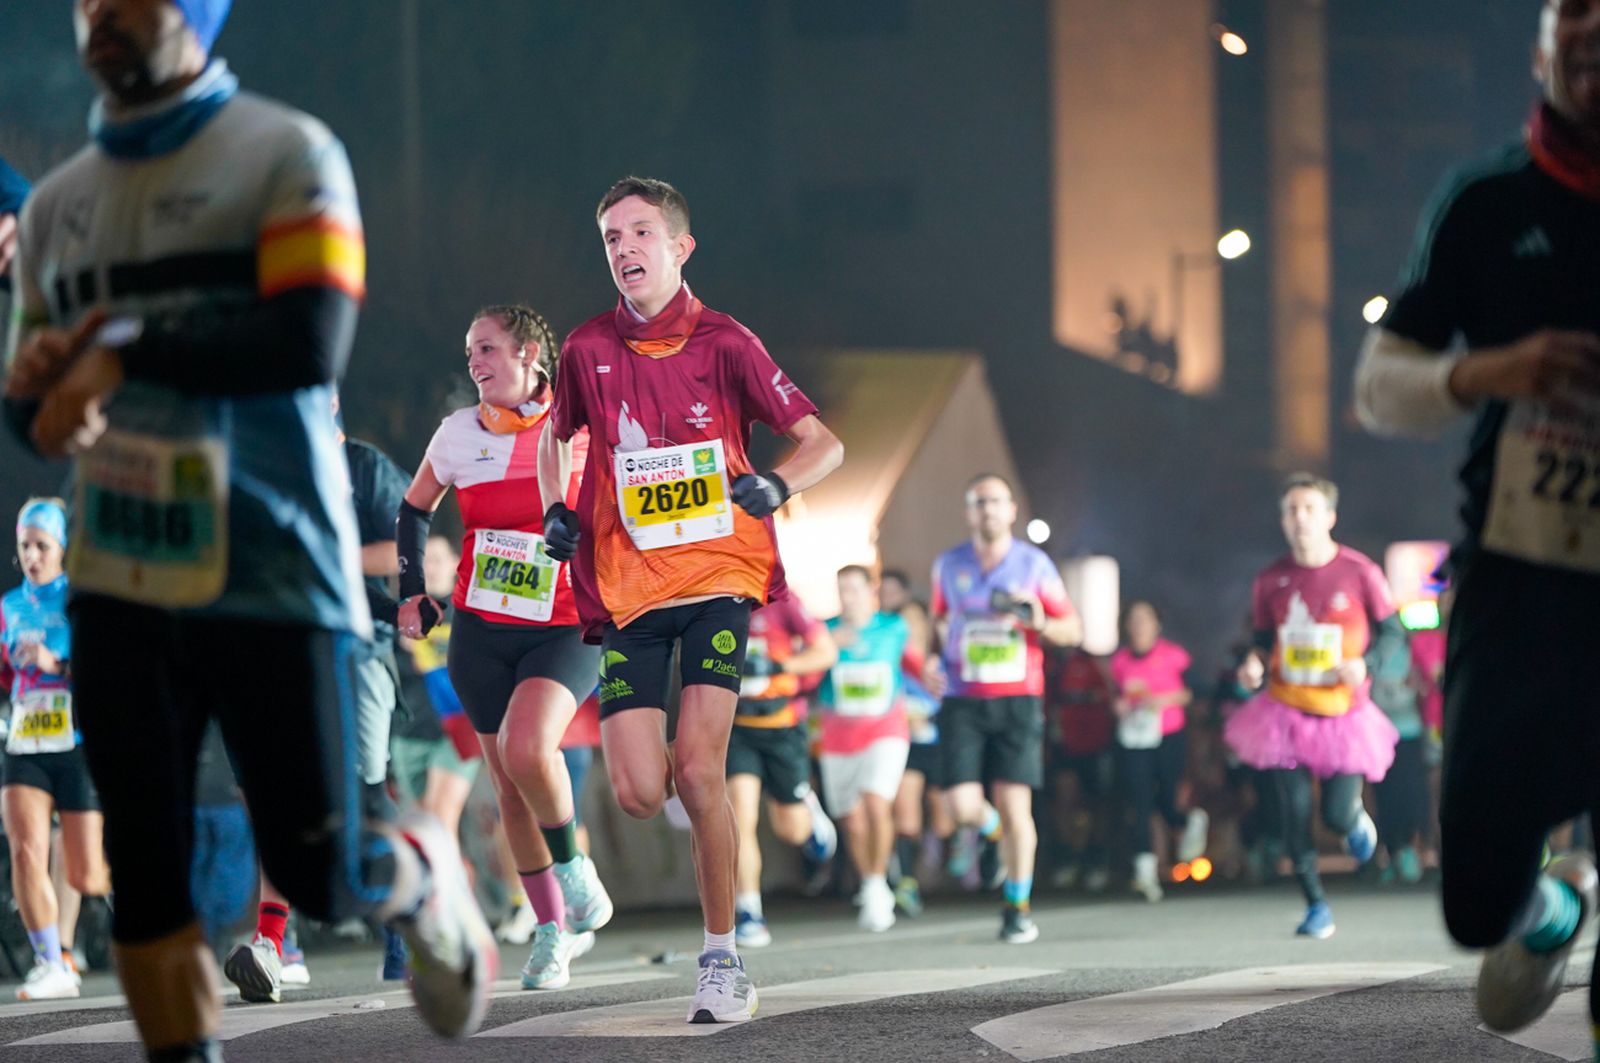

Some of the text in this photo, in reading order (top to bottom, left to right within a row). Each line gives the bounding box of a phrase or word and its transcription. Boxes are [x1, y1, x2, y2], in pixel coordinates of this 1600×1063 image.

[638, 458, 669, 471] NOCHE
[671, 456, 683, 467] DE
[628, 474, 648, 486] SAN
[638, 478, 709, 515] 2620
[496, 537, 520, 549] NOCHE
[483, 545, 499, 556] SAN
[483, 556, 540, 590] 8464
